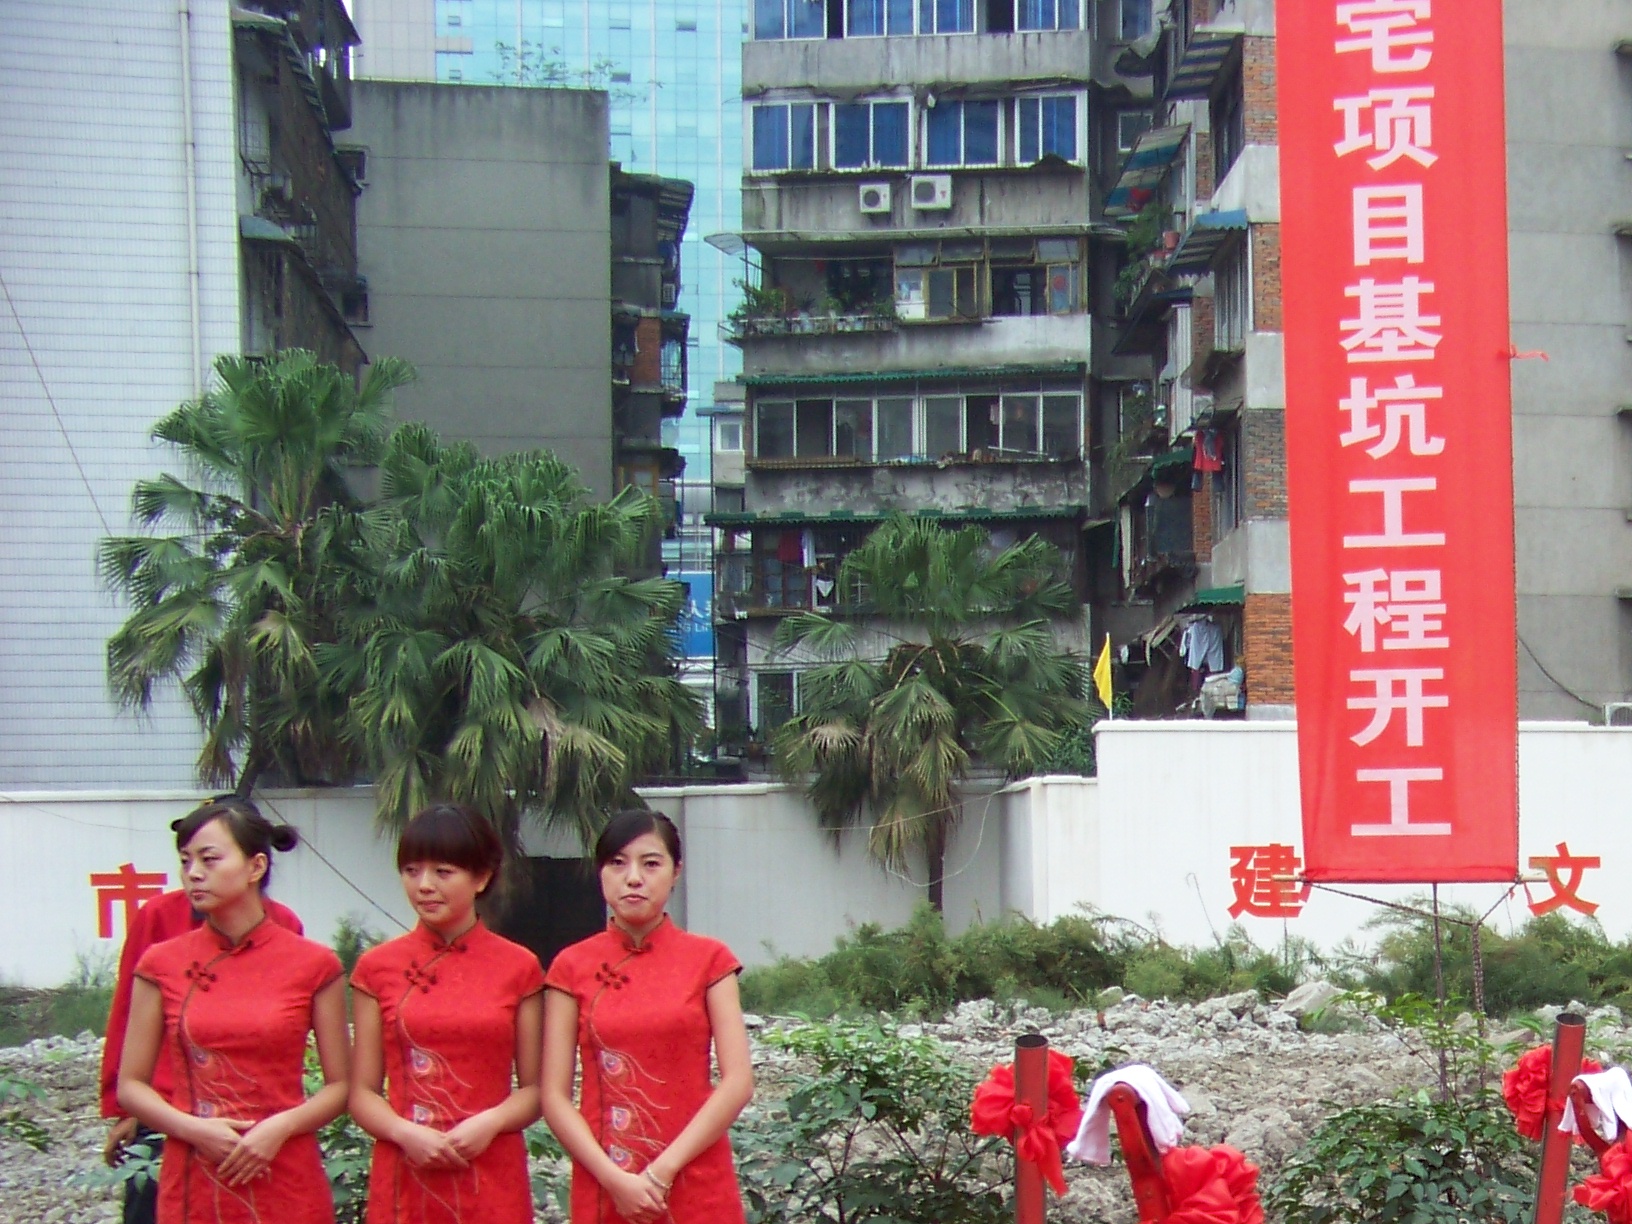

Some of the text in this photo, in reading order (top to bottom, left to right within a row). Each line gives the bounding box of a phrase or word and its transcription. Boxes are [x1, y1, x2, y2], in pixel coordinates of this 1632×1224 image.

[1333, 0, 1452, 836] 宅项目基坑工程开工
